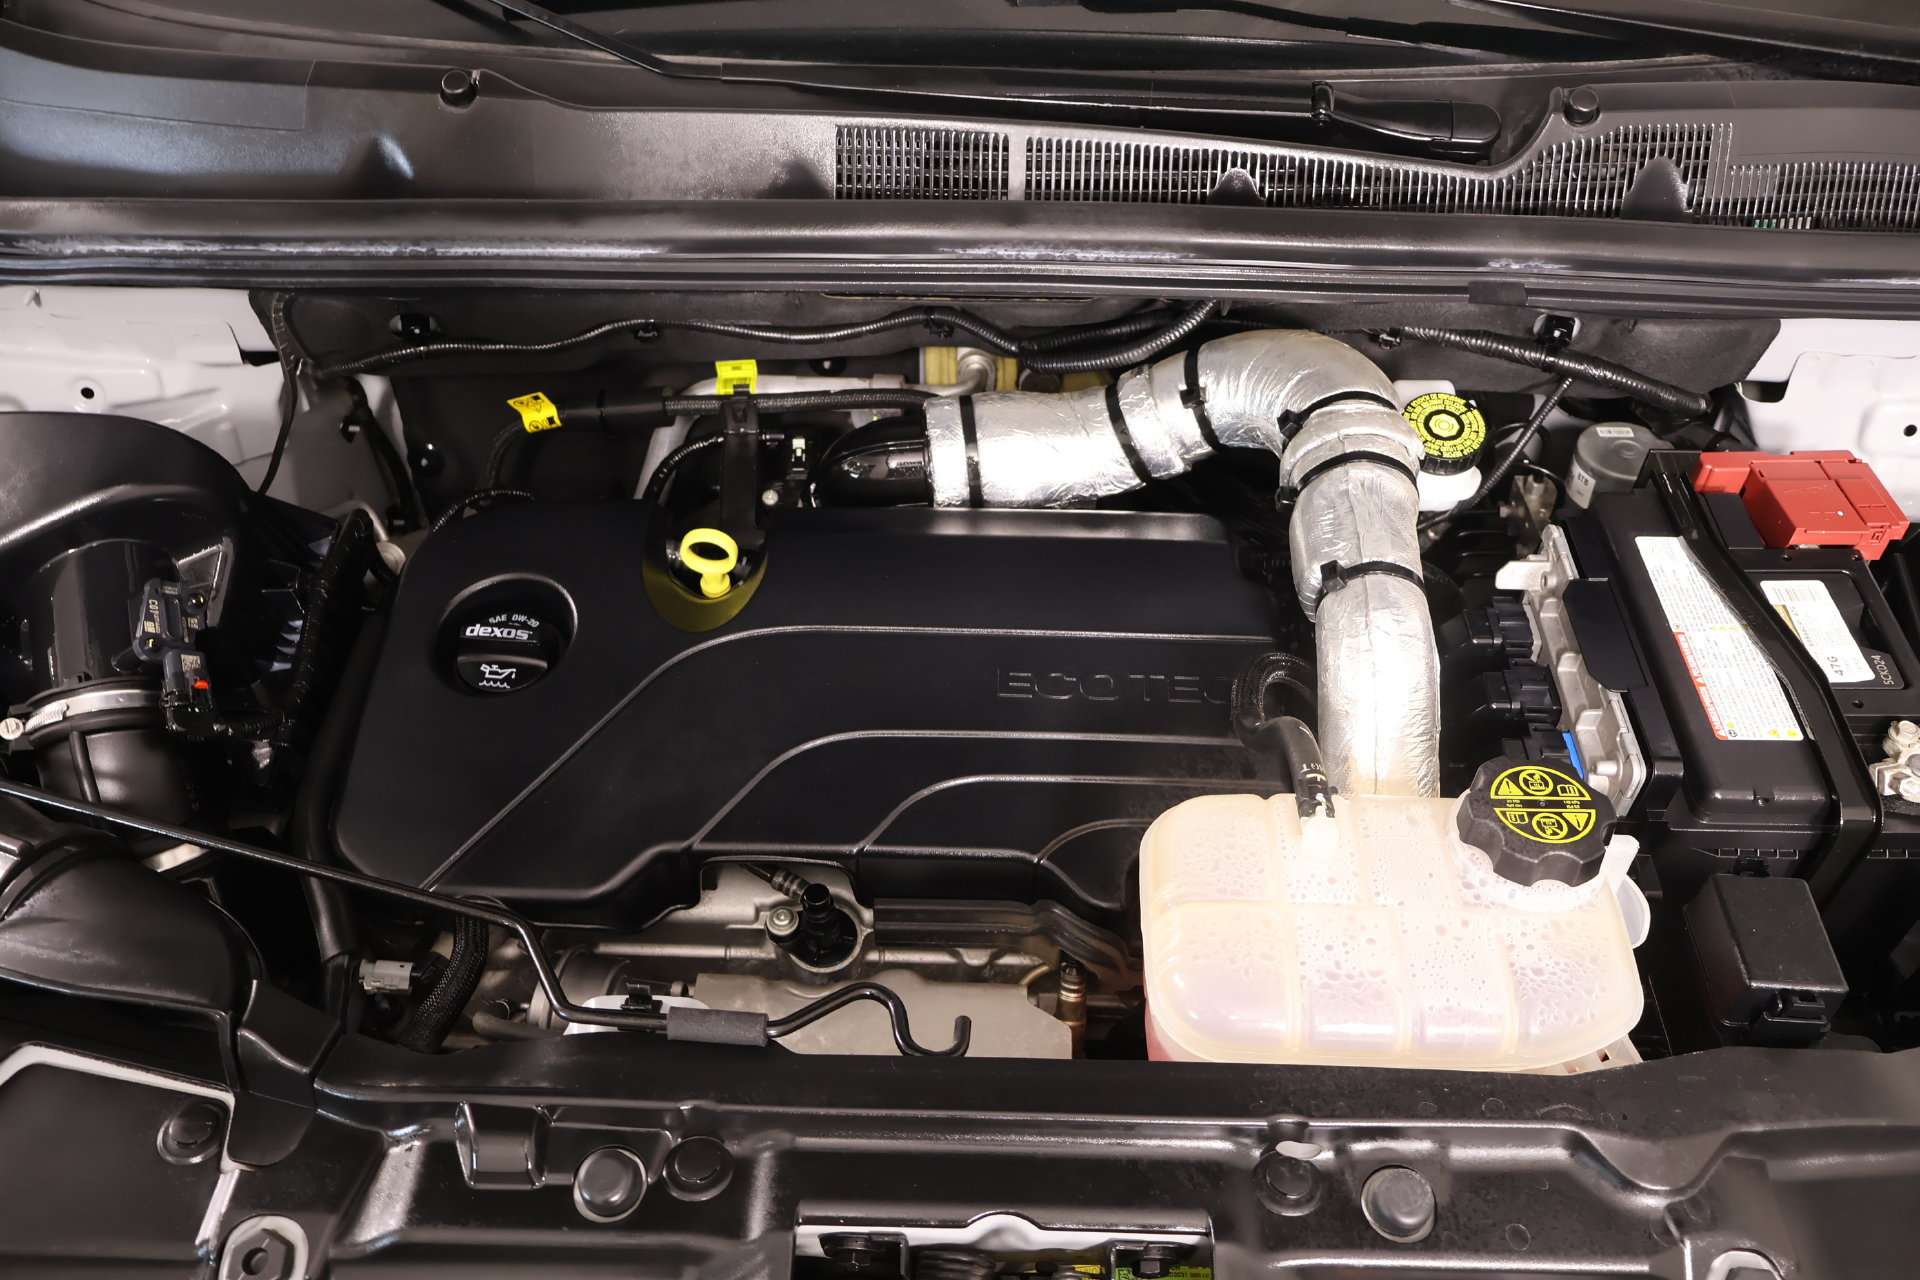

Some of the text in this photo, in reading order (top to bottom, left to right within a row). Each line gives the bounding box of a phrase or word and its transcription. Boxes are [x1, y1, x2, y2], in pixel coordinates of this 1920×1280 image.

[488, 614, 540, 628] SAE 0W-20
[465, 624, 530, 640] dexos
[1827, 655, 1844, 677] 47G
